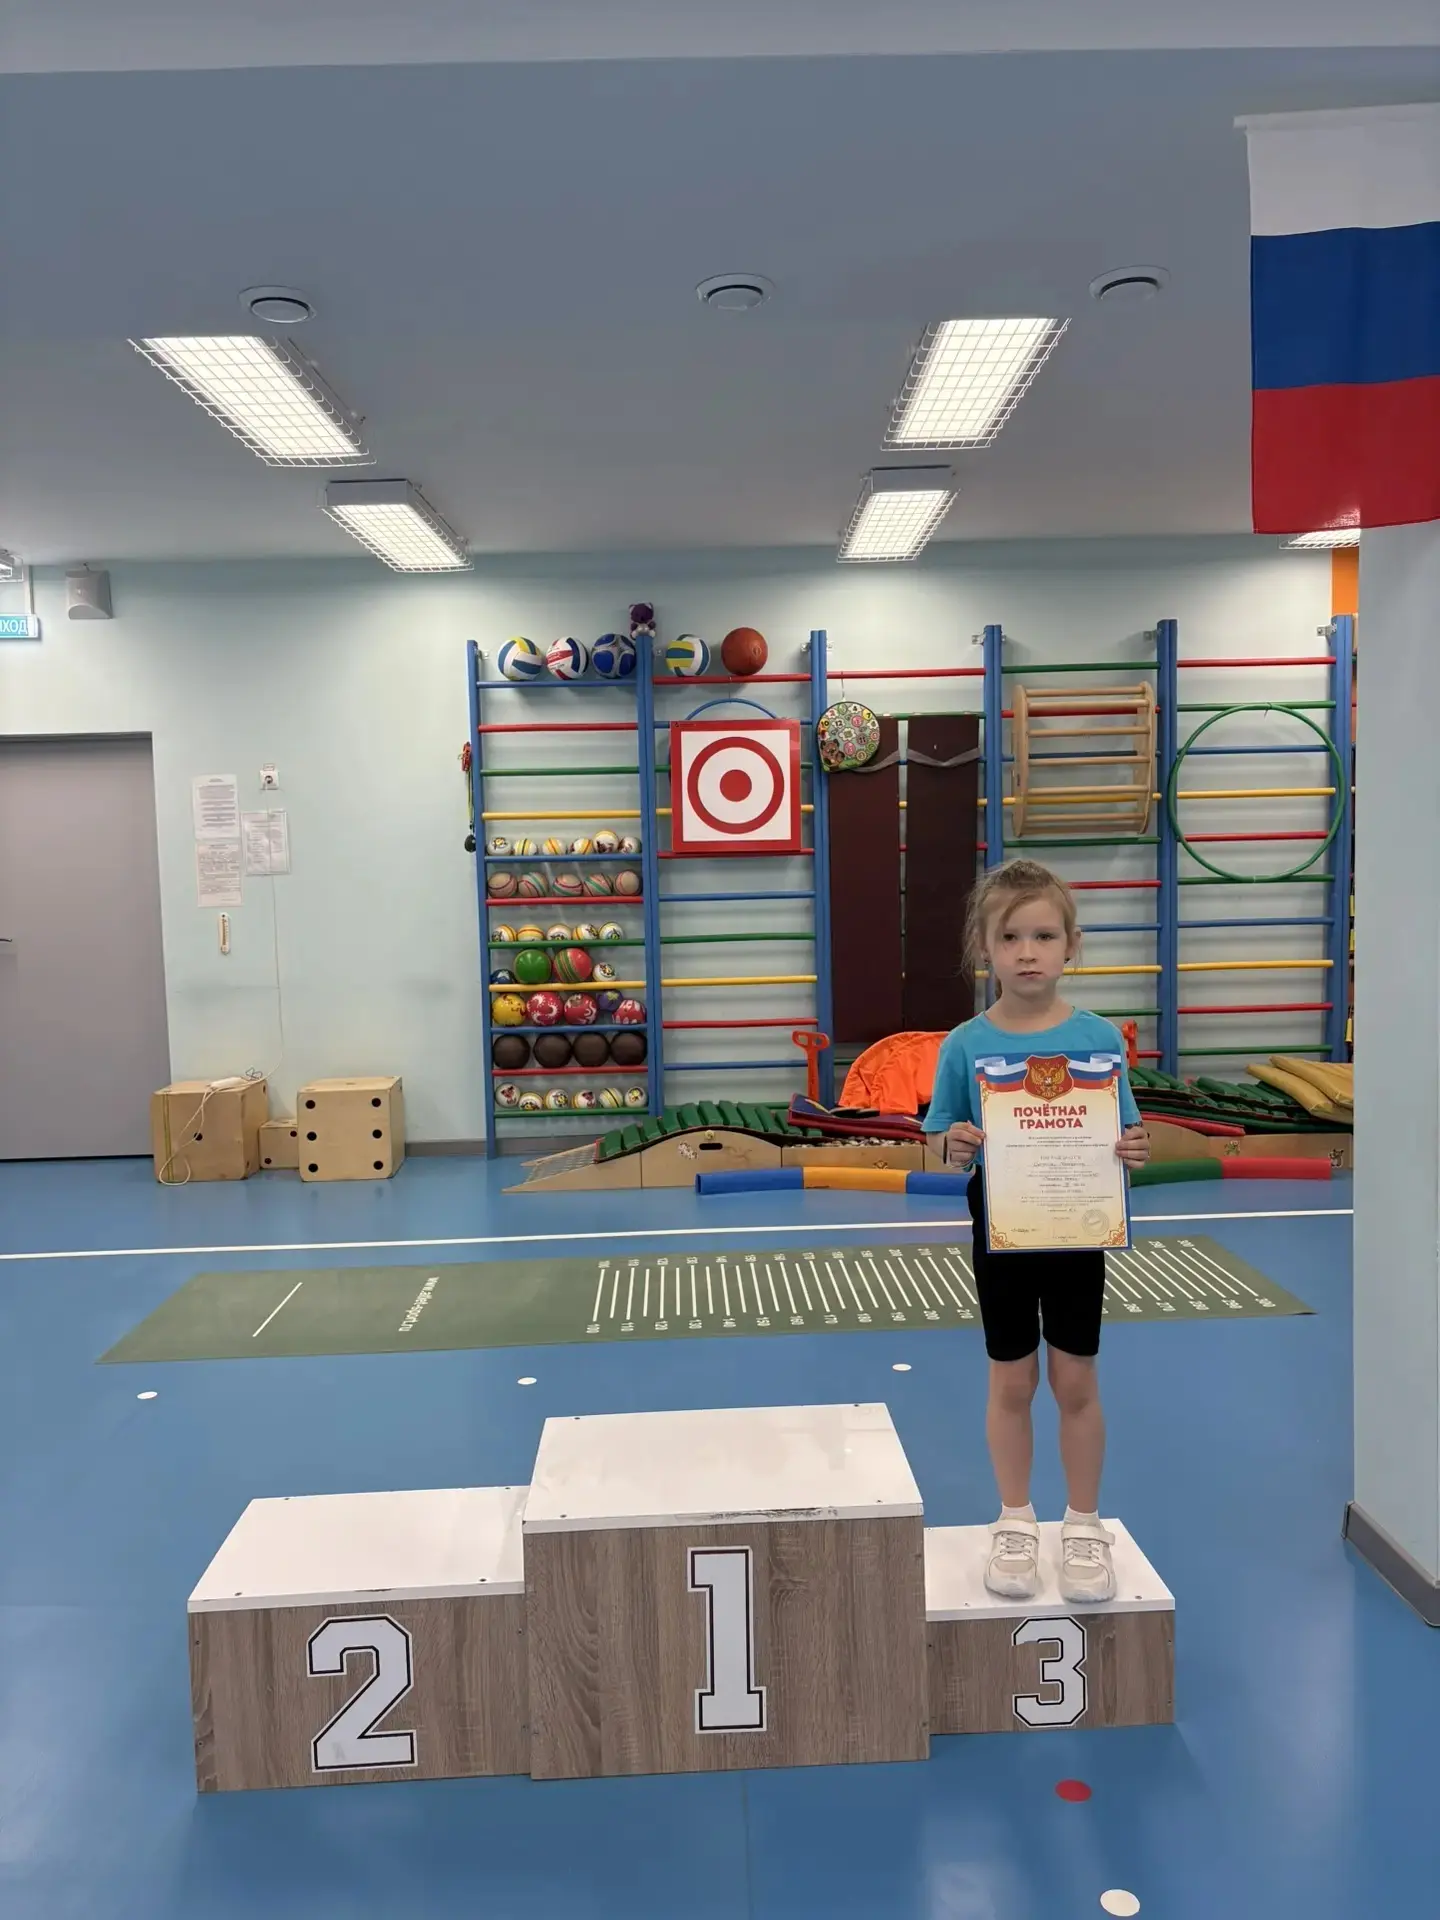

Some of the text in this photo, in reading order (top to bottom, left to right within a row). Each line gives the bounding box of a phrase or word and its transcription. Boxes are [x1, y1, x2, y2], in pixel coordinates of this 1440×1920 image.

[1013, 1103, 1087, 1117] ПОЧЁТНАЯ
[1019, 1118, 1083, 1129] ГРАМОТА
[306, 1614, 417, 1773] 2
[687, 1546, 768, 1734] 1
[1011, 1615, 1088, 1728] 3
